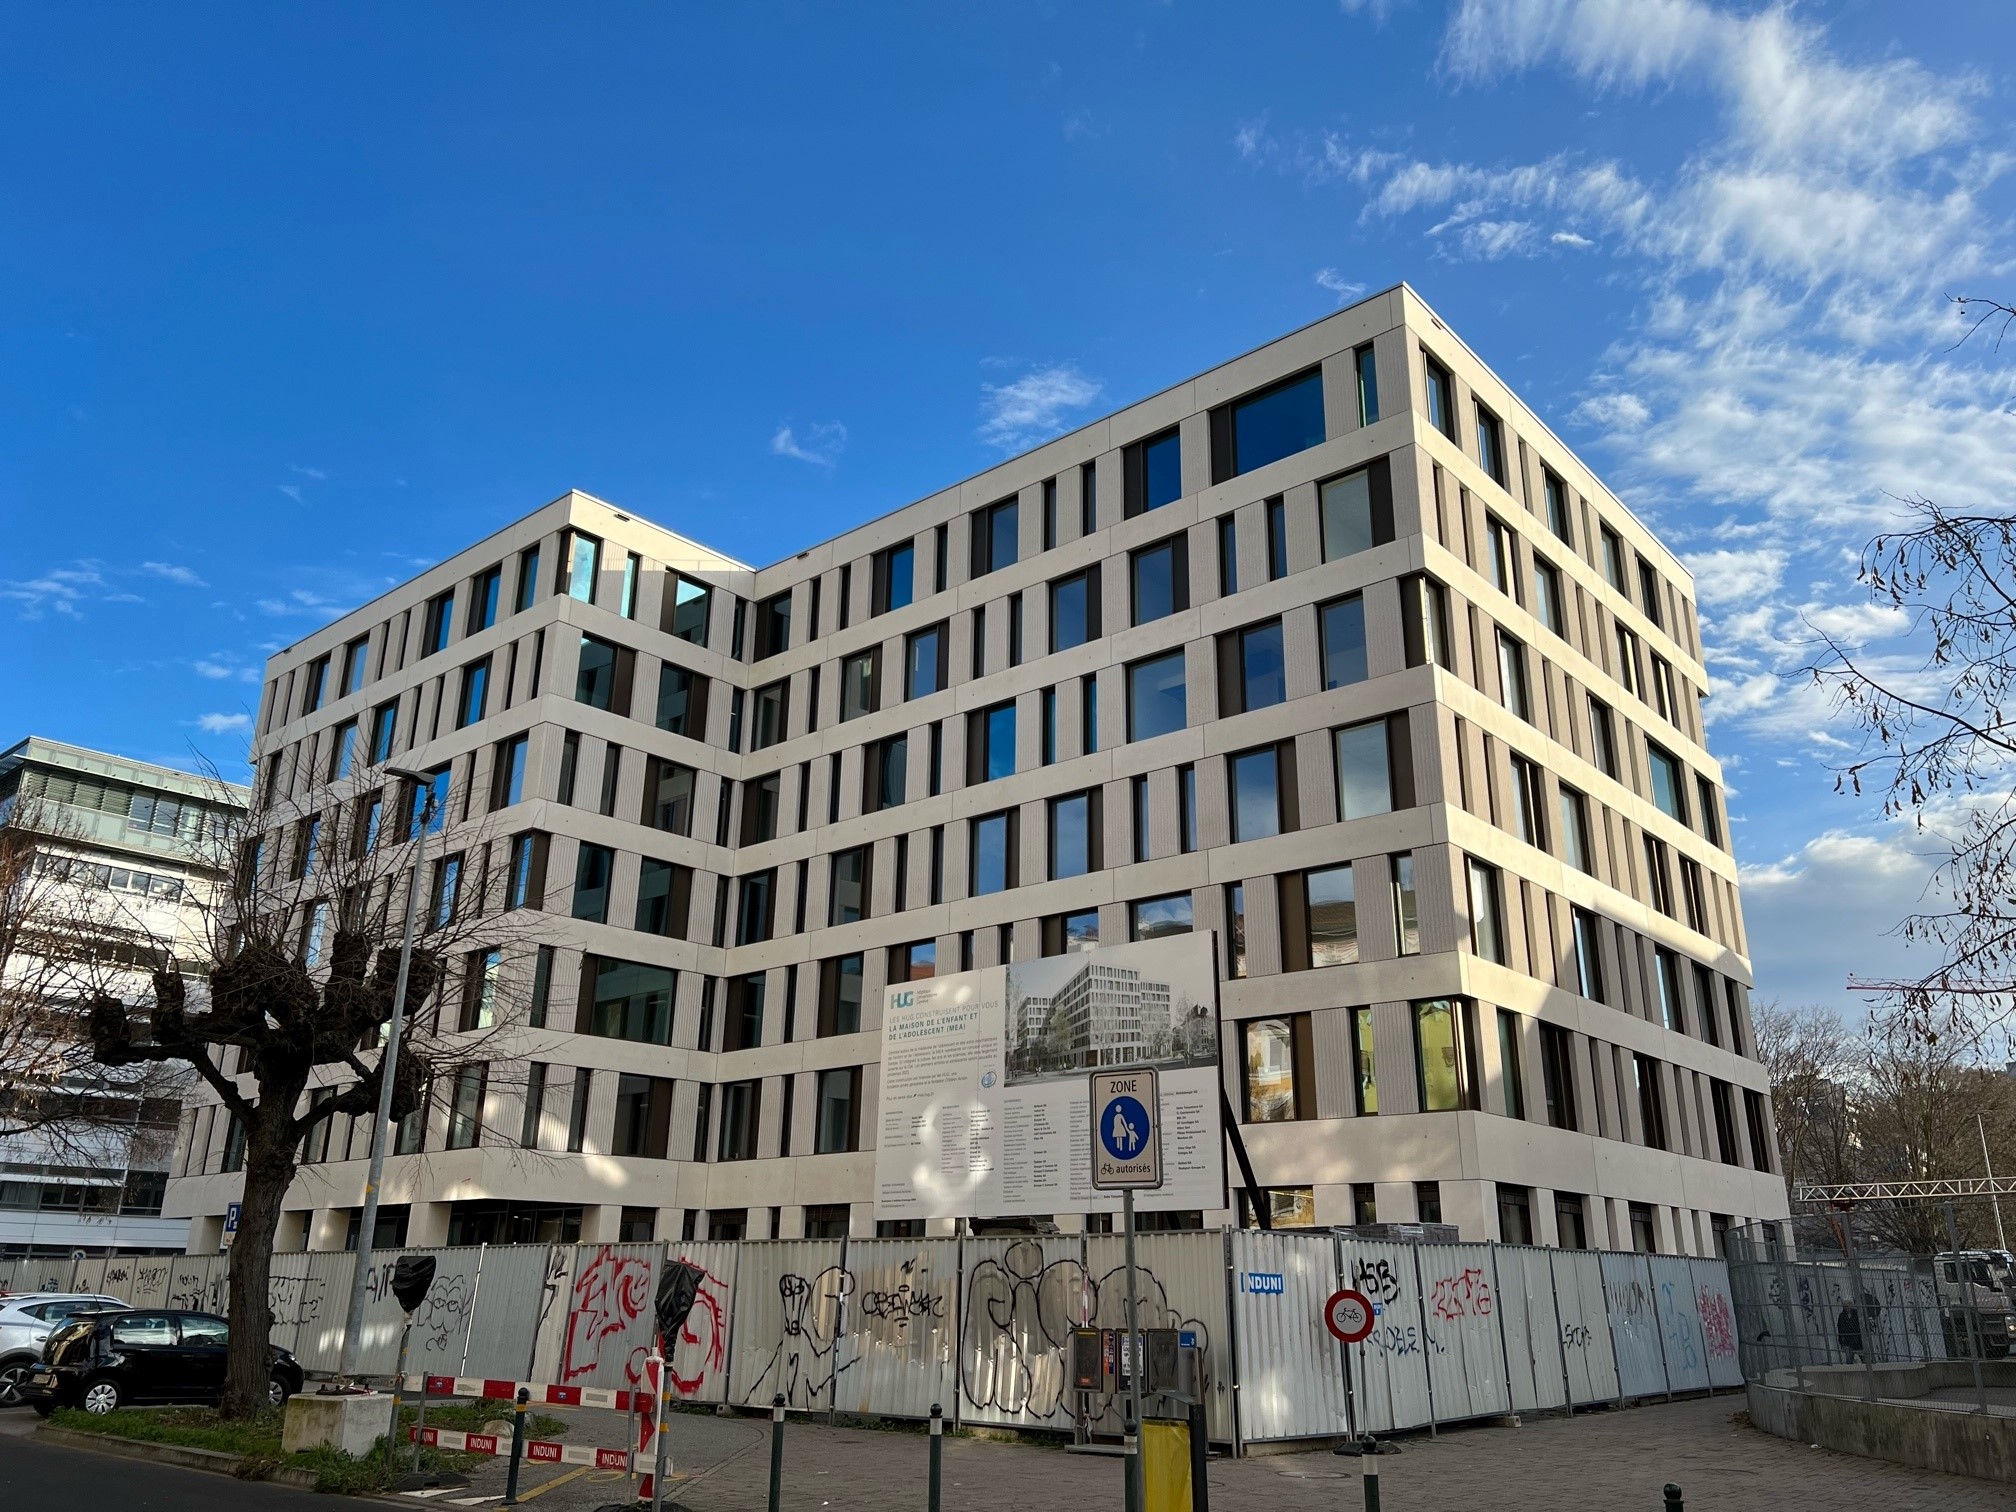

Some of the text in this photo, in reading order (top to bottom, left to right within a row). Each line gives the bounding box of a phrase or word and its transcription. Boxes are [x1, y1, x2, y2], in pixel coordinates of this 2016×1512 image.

[890, 991, 913, 1009] HUG
[890, 1000, 999, 1024] LES HUG CONSTRUISENT POUR VOUS
[899, 1021, 924, 1030] MAISON
[926, 1018, 935, 1026] DE
[937, 1014, 967, 1025] L'ENFANT
[888, 1024, 966, 1041] DE L'ADOLESCENT (MEA)
[1110, 1080, 1137, 1093] ZONE
[1116, 1163, 1151, 1174] autorisés
[228, 1207, 237, 1228] P
[1243, 1275, 1282, 1290] NDUNI
[470, 1437, 493, 1450] INDUNI
[532, 1445, 558, 1458] INDUNI
[601, 1453, 628, 1467] INDUNI
